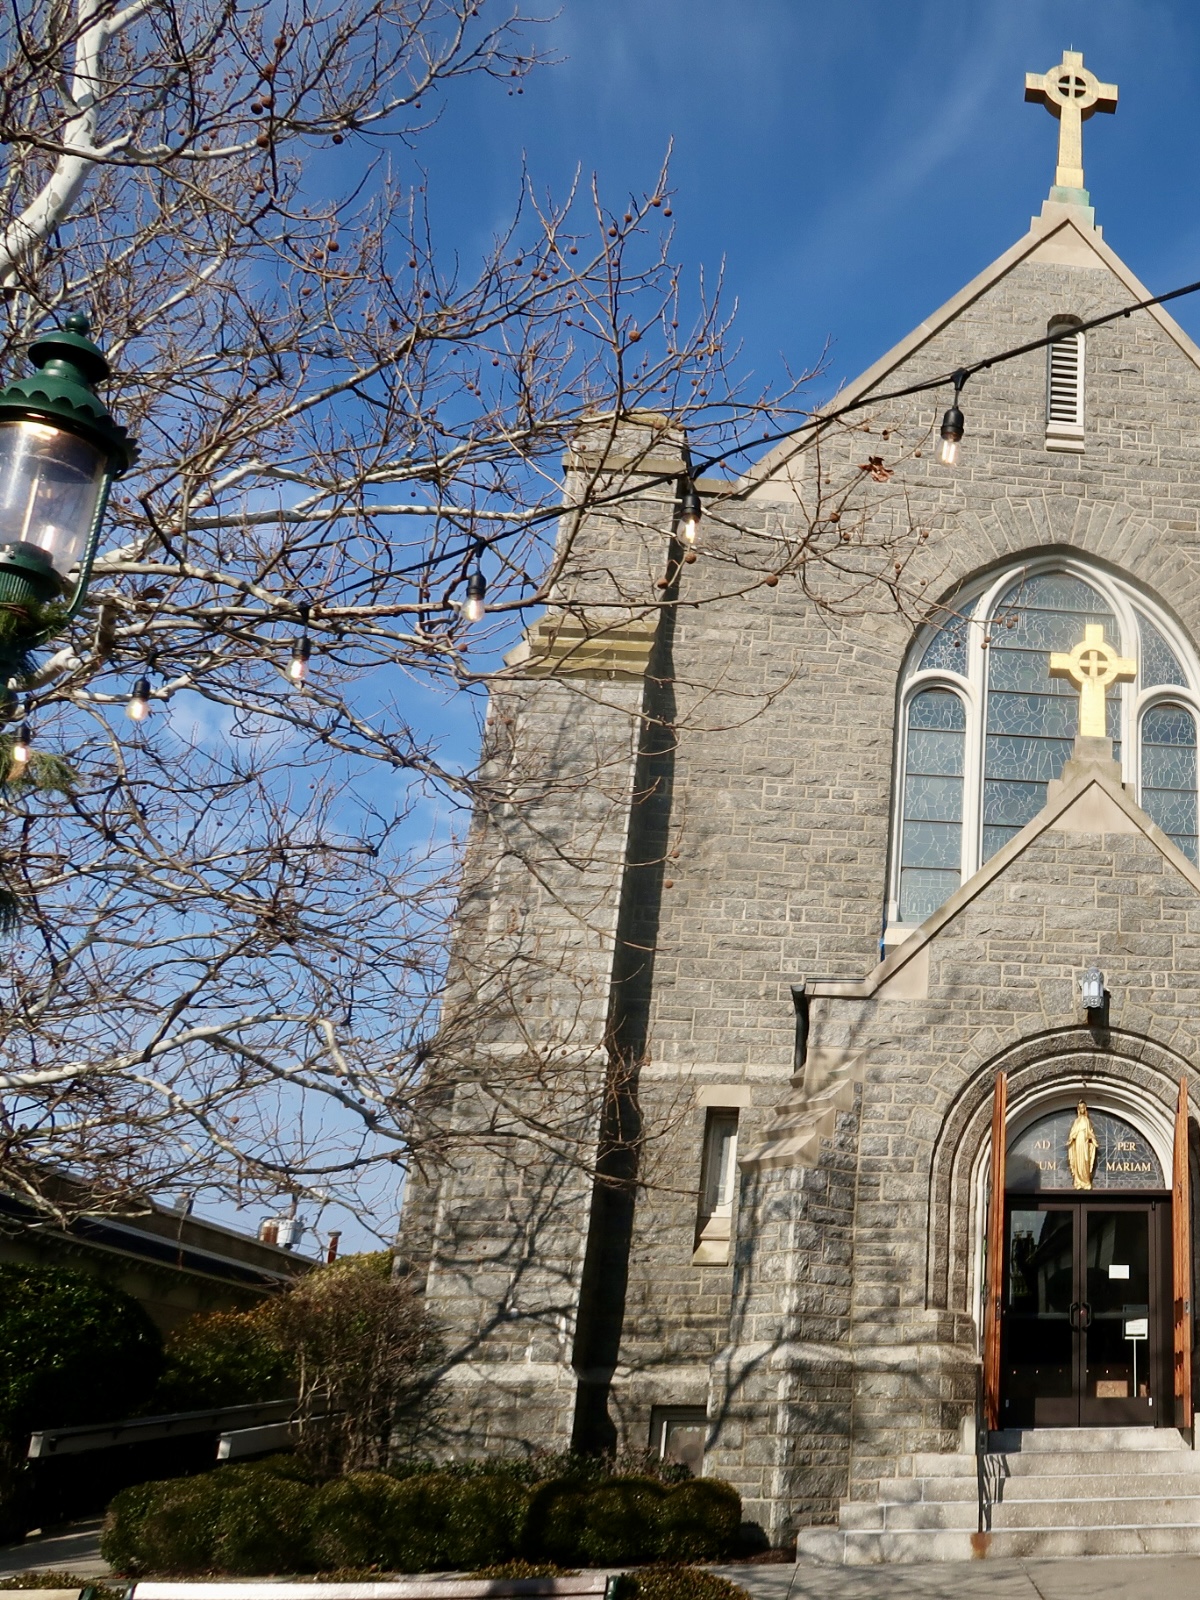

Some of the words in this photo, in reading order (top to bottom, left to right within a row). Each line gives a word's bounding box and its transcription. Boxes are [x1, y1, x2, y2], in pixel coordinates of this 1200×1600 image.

[1034, 1141, 1051, 1150] AD
[1117, 1141, 1136, 1151] PER
[1106, 1162, 1151, 1172] MARIAM
